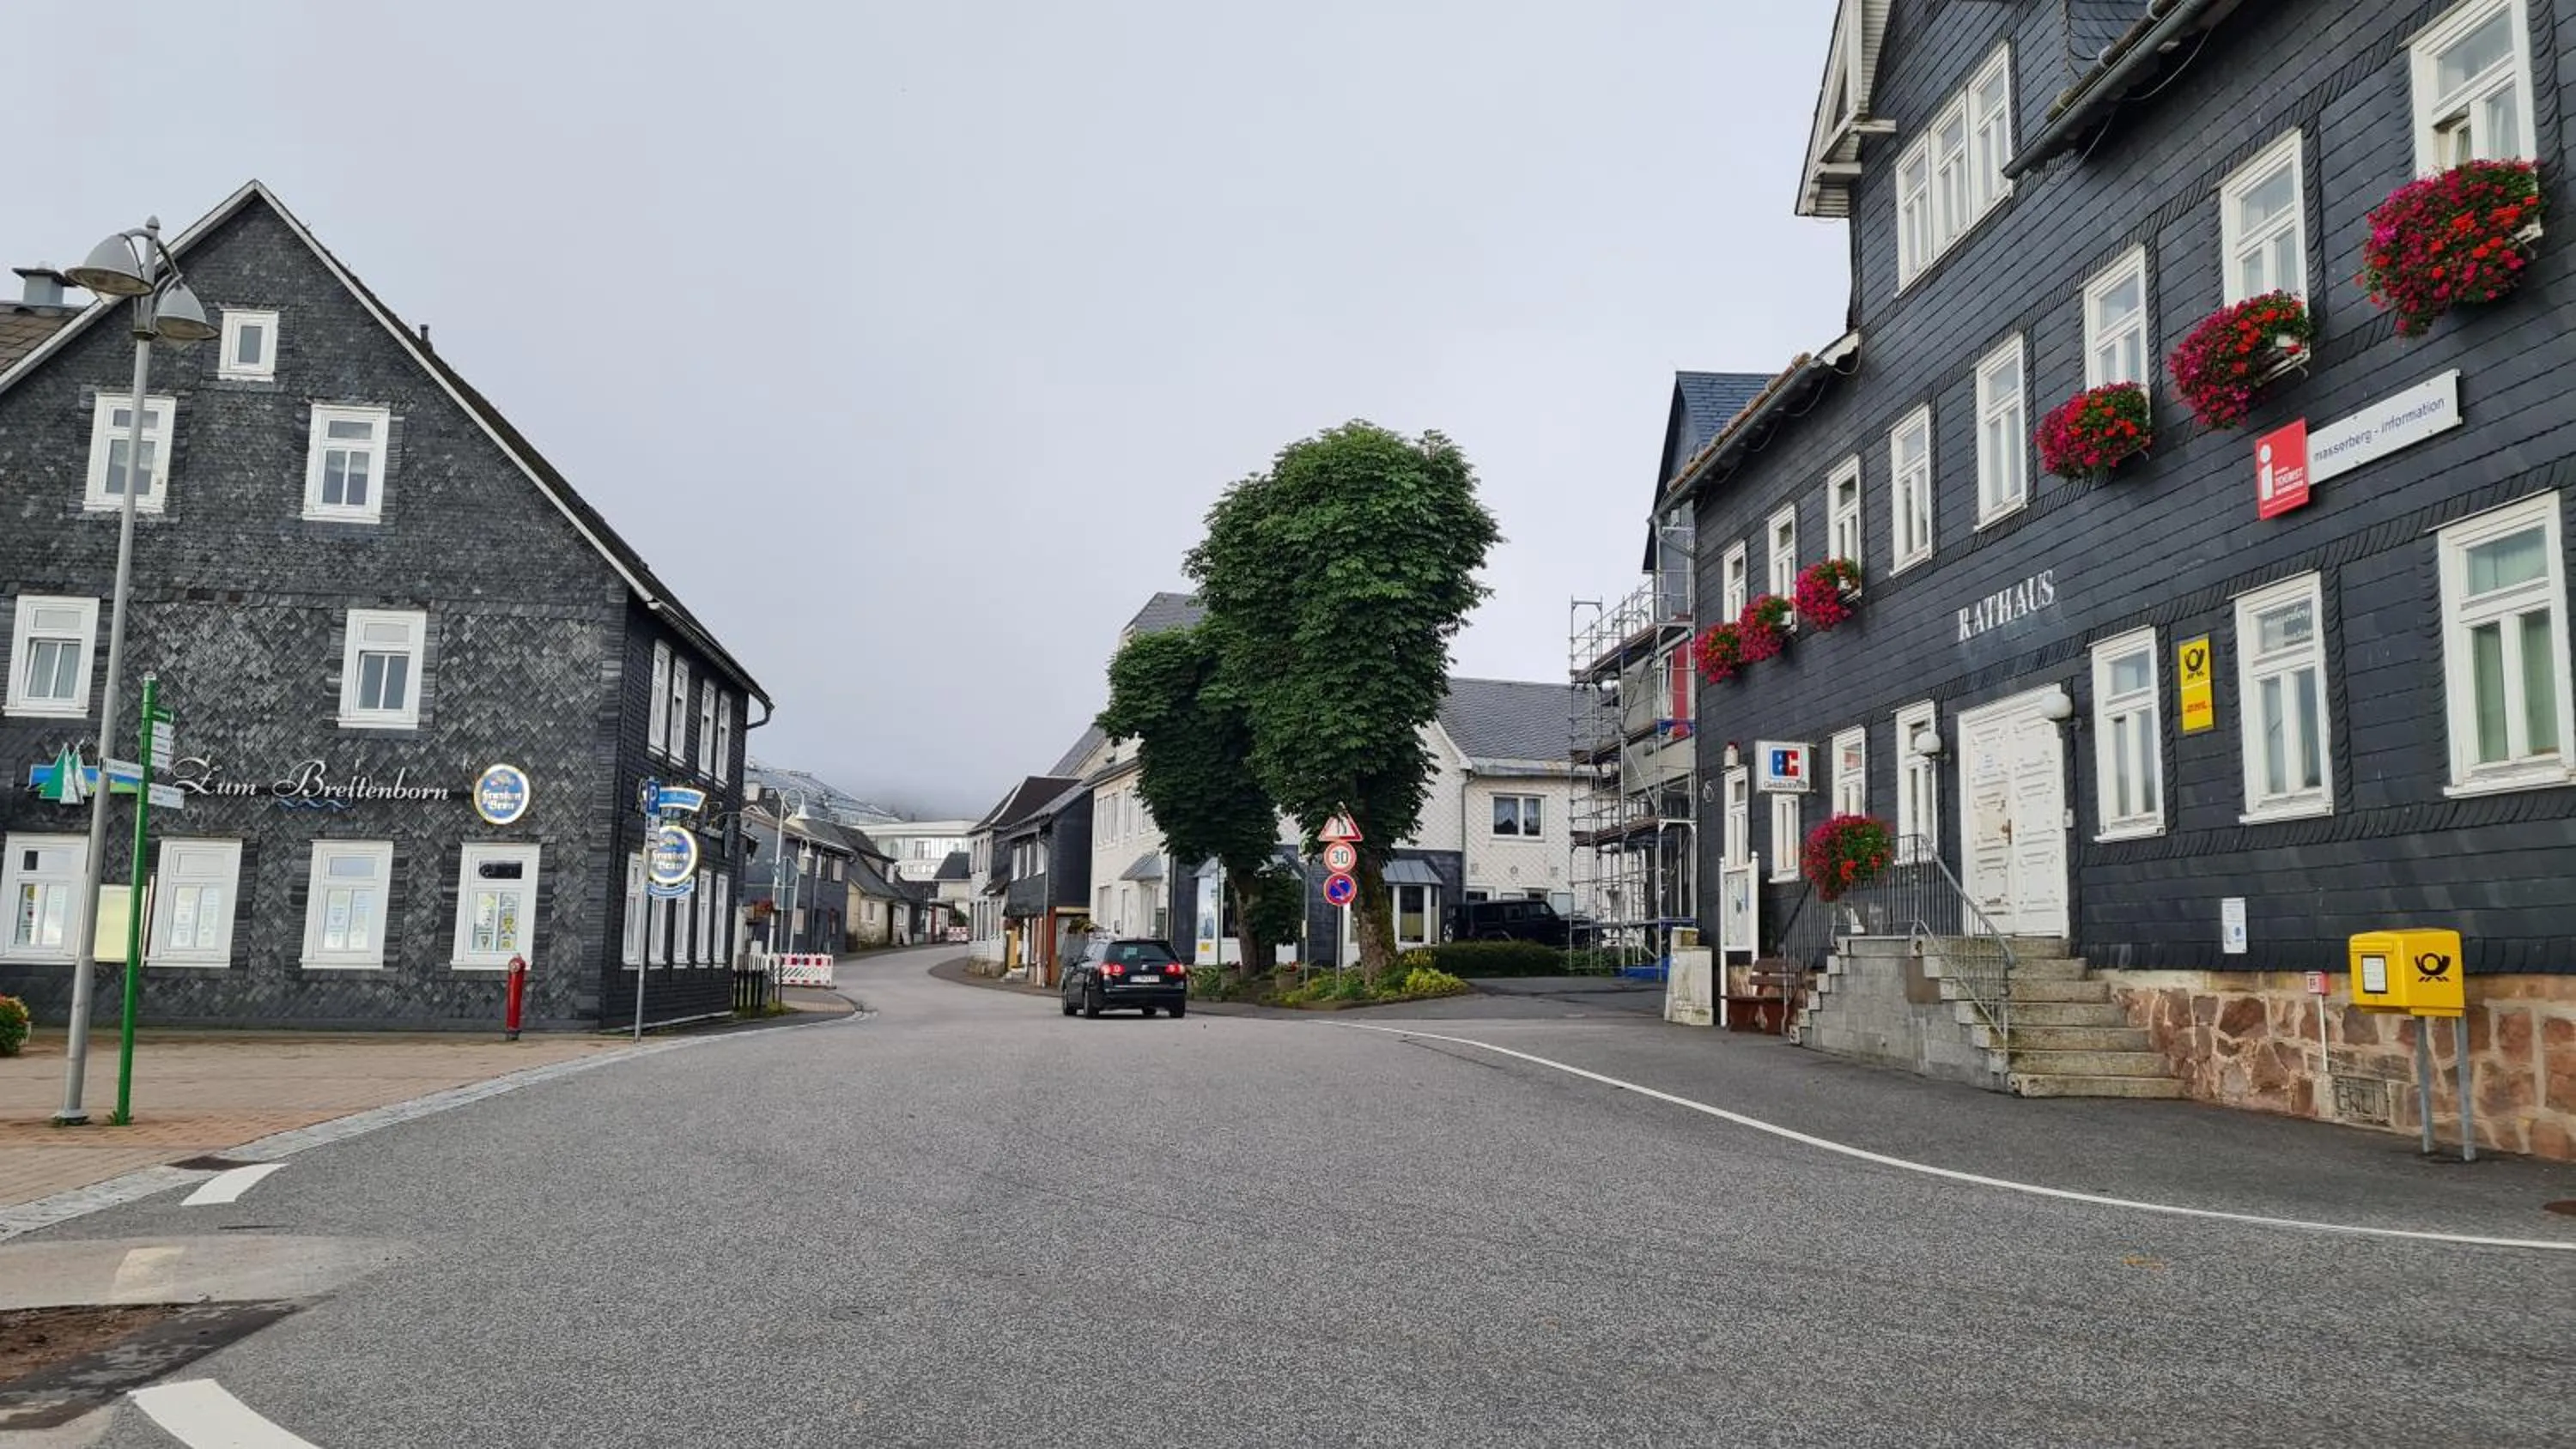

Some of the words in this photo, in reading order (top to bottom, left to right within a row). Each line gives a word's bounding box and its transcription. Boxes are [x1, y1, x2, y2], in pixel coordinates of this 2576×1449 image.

[2314, 428, 2372, 462] masserberg
[2381, 397, 2445, 434] information
[1958, 569, 2055, 642] RATHAUS
[173, 755, 258, 796] Zum
[271, 759, 450, 801] Breitenborn
[1332, 851, 1349, 864] 30
